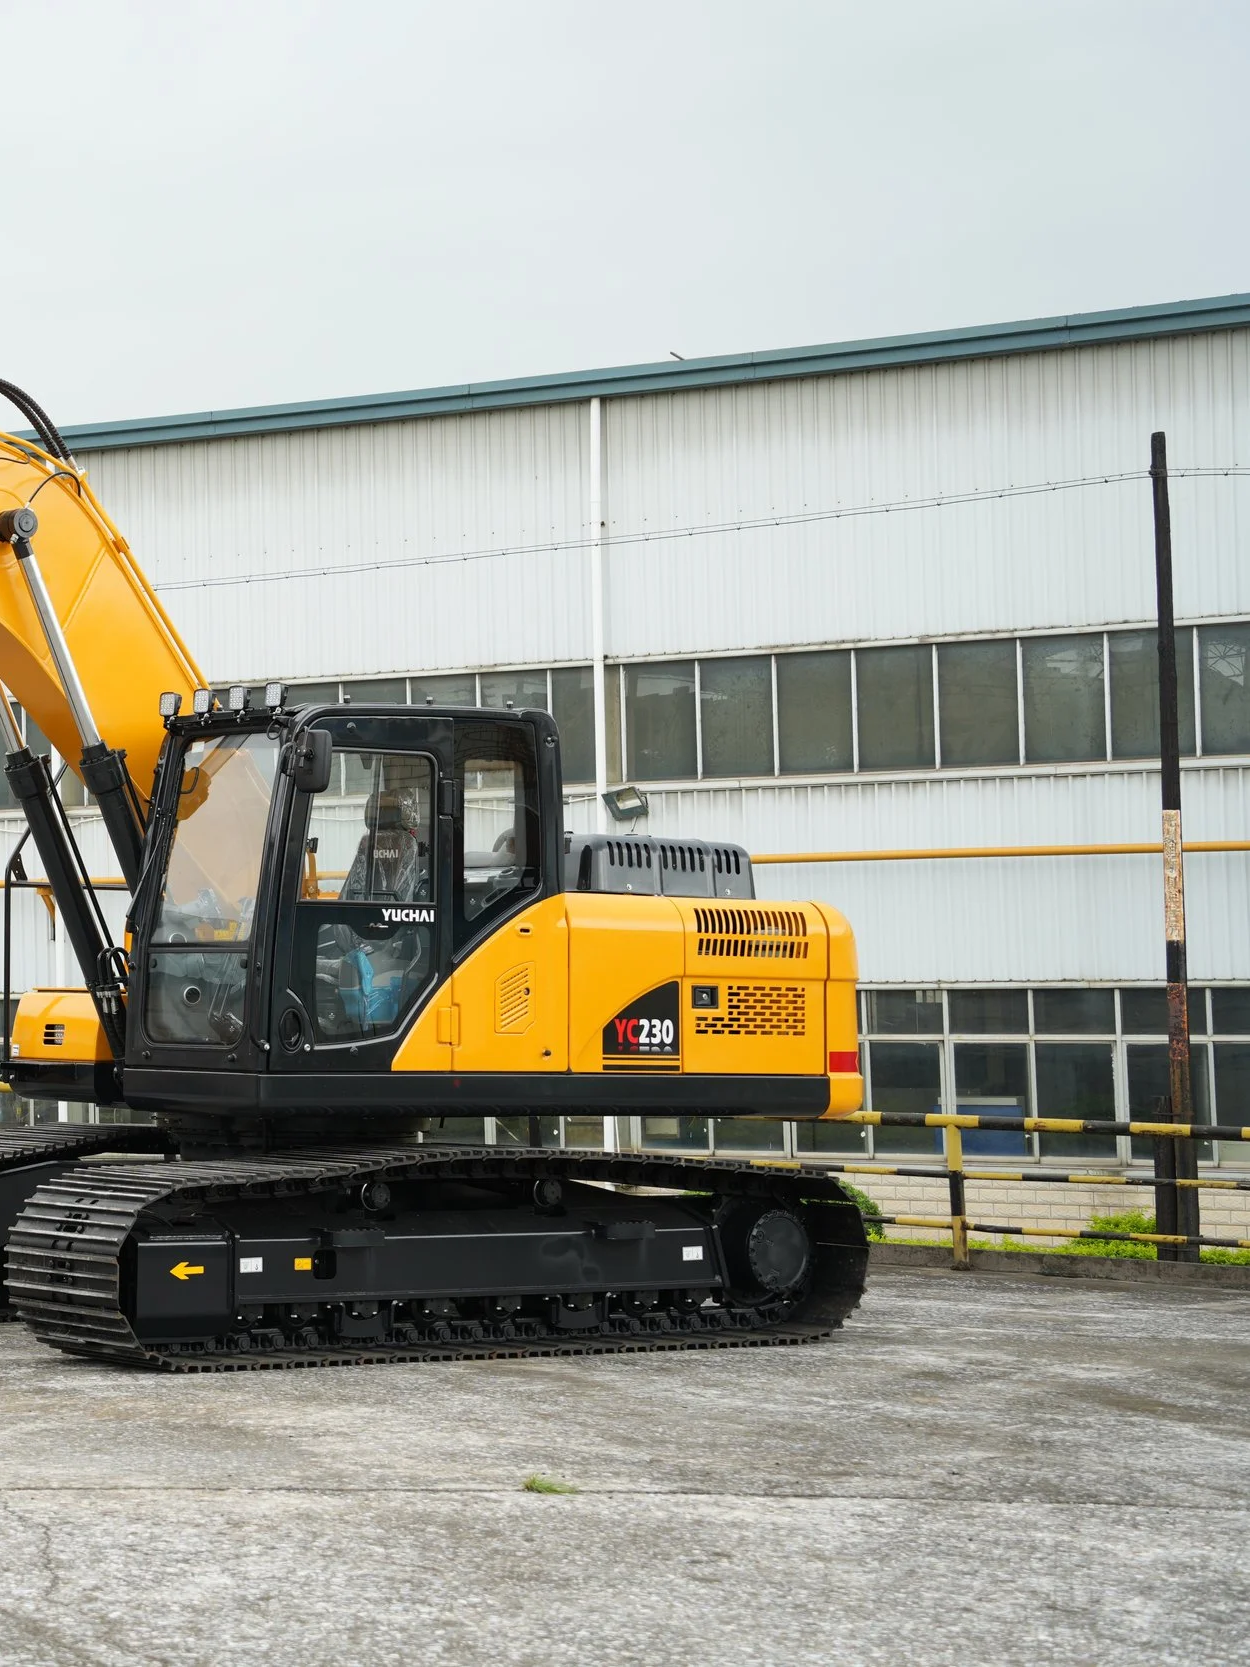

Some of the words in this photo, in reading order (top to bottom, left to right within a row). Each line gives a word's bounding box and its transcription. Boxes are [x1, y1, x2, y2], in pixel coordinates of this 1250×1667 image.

[373, 849, 399, 859] UCHAI
[381, 908, 435, 923] YUCHAI
[614, 1018, 674, 1044] YC230
